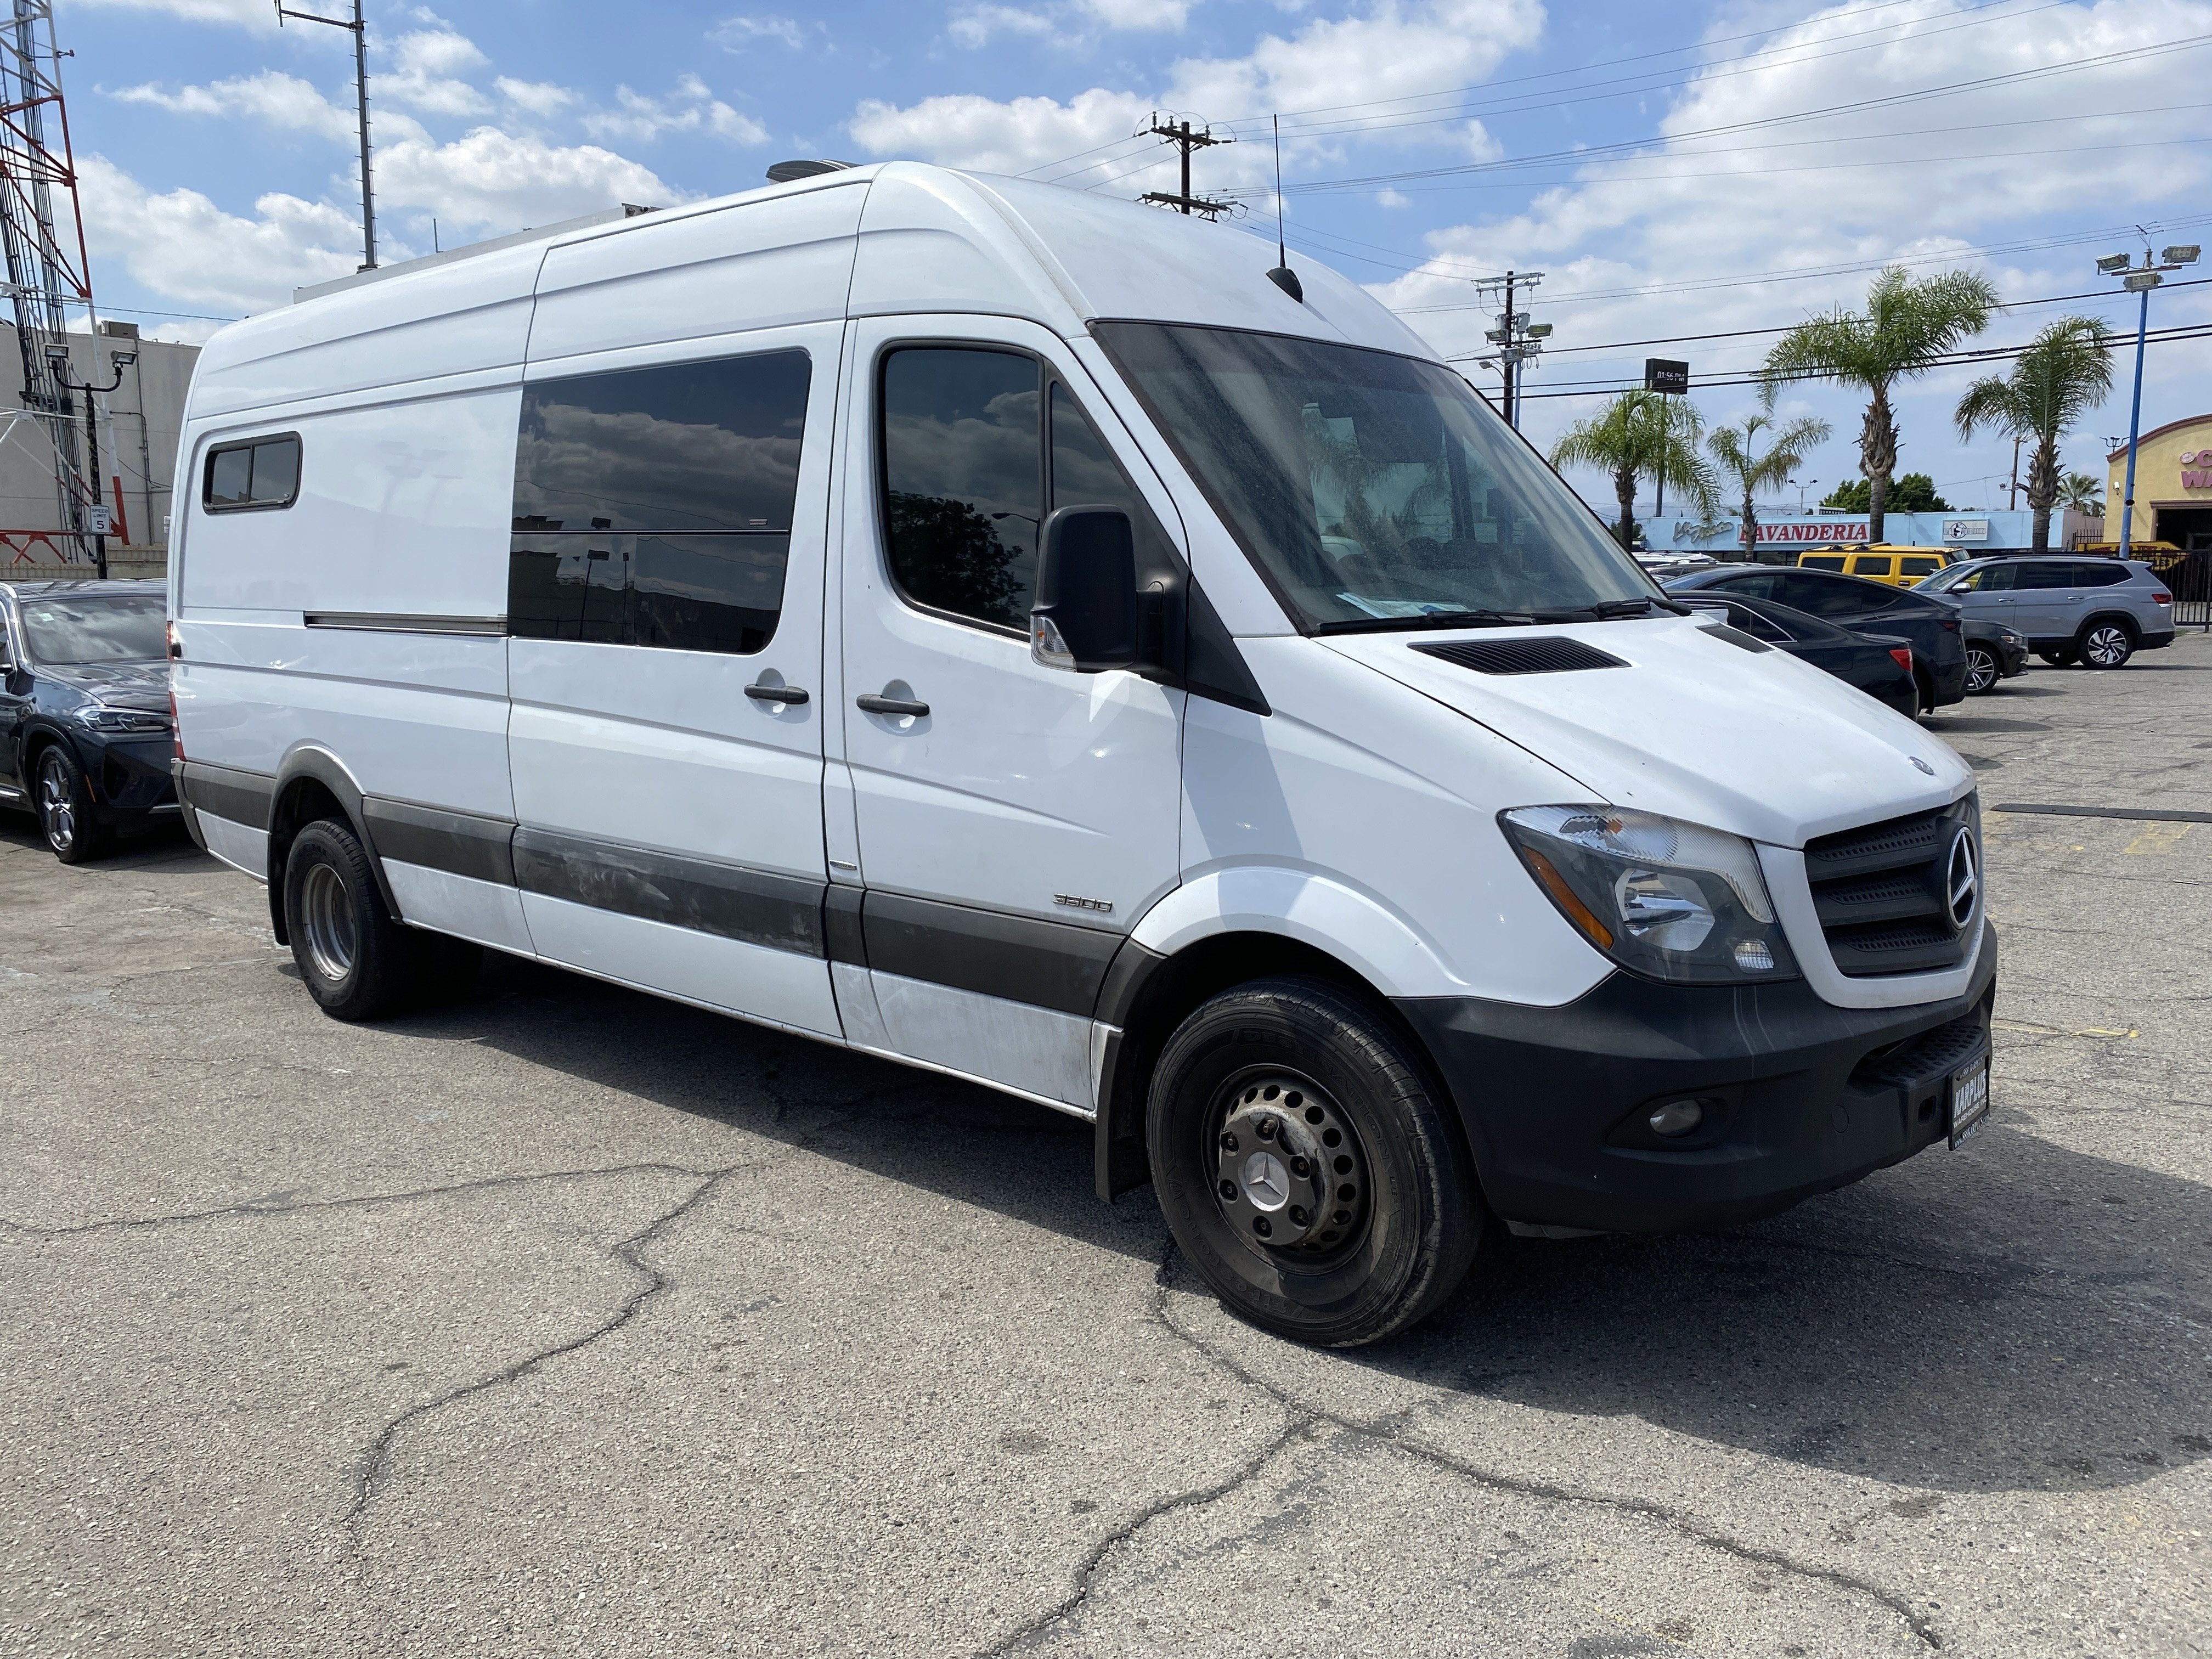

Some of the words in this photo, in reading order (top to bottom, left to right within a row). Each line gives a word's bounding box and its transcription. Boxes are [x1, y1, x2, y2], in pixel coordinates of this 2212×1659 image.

[97, 520, 104, 529] 5
[1052, 893, 1113, 912] 3500
[1954, 1069, 1986, 1119] KARPLUS
[1953, 1102, 1980, 1128] WAREHOUSE
